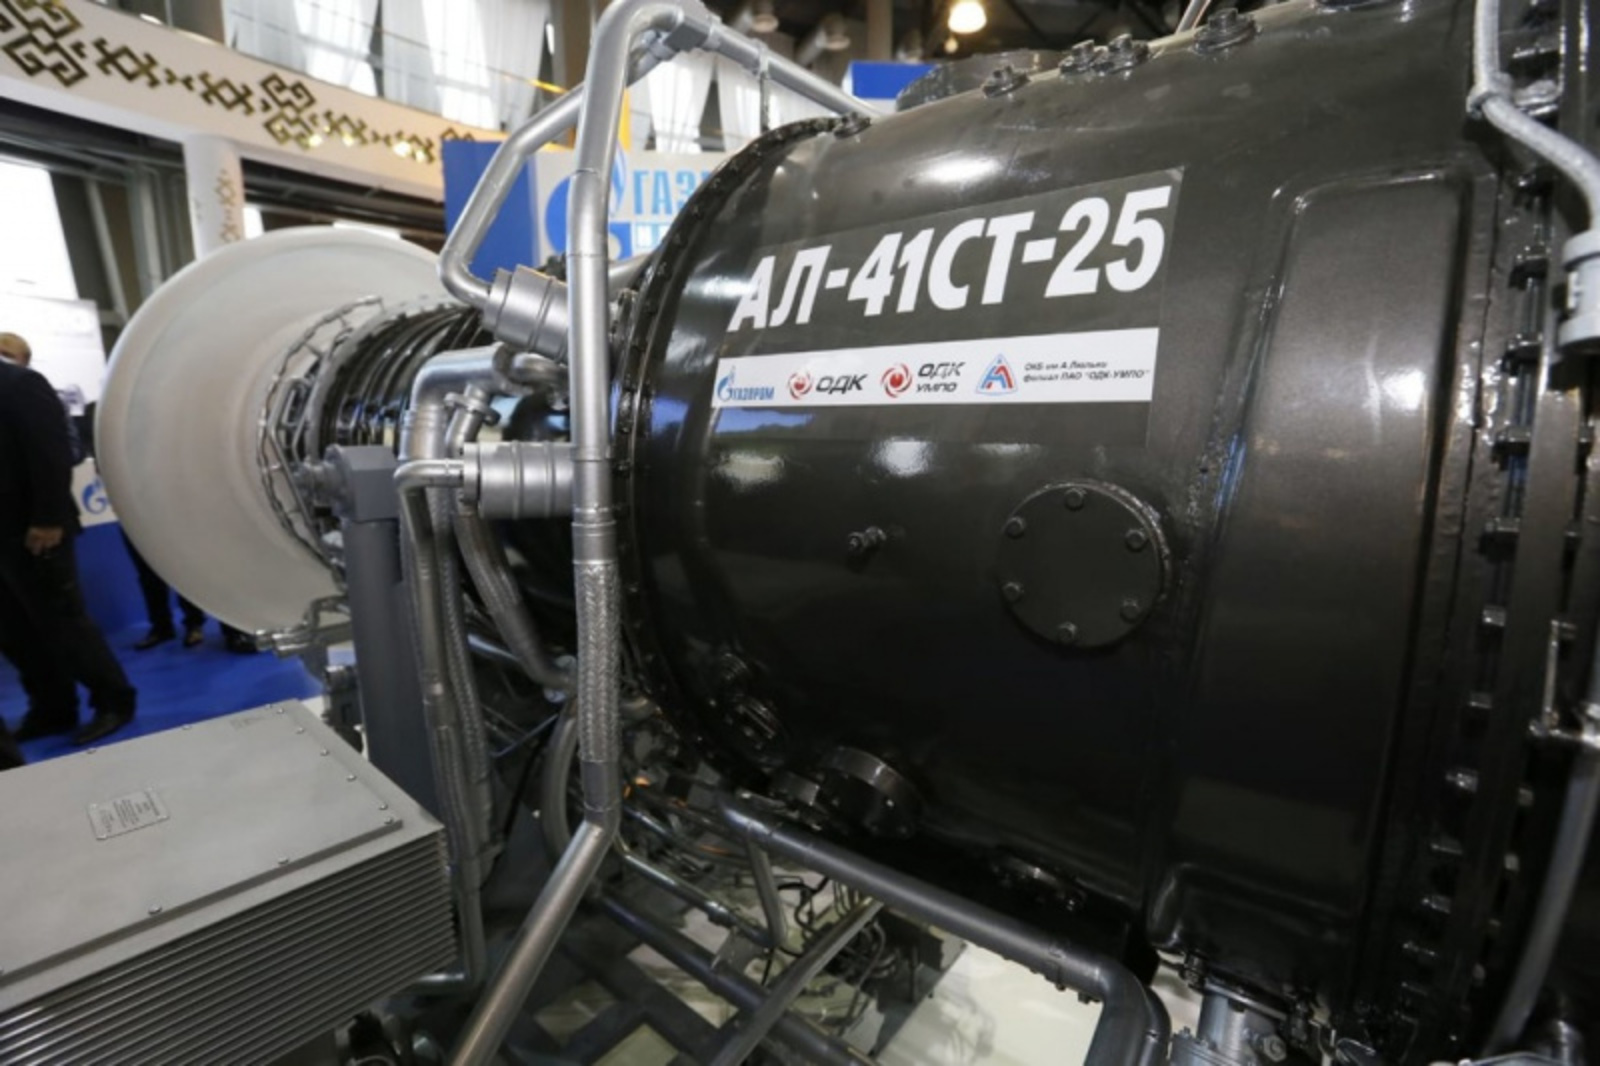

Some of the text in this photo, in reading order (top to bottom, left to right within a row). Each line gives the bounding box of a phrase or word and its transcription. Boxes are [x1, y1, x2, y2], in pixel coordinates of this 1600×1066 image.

[633, 170, 711, 215] ГАЗ
[726, 185, 1172, 332] АЛ-41СТ-25
[917, 361, 966, 380] ОДК
[815, 373, 868, 395] ОДК
[916, 382, 958, 393] УМПО
